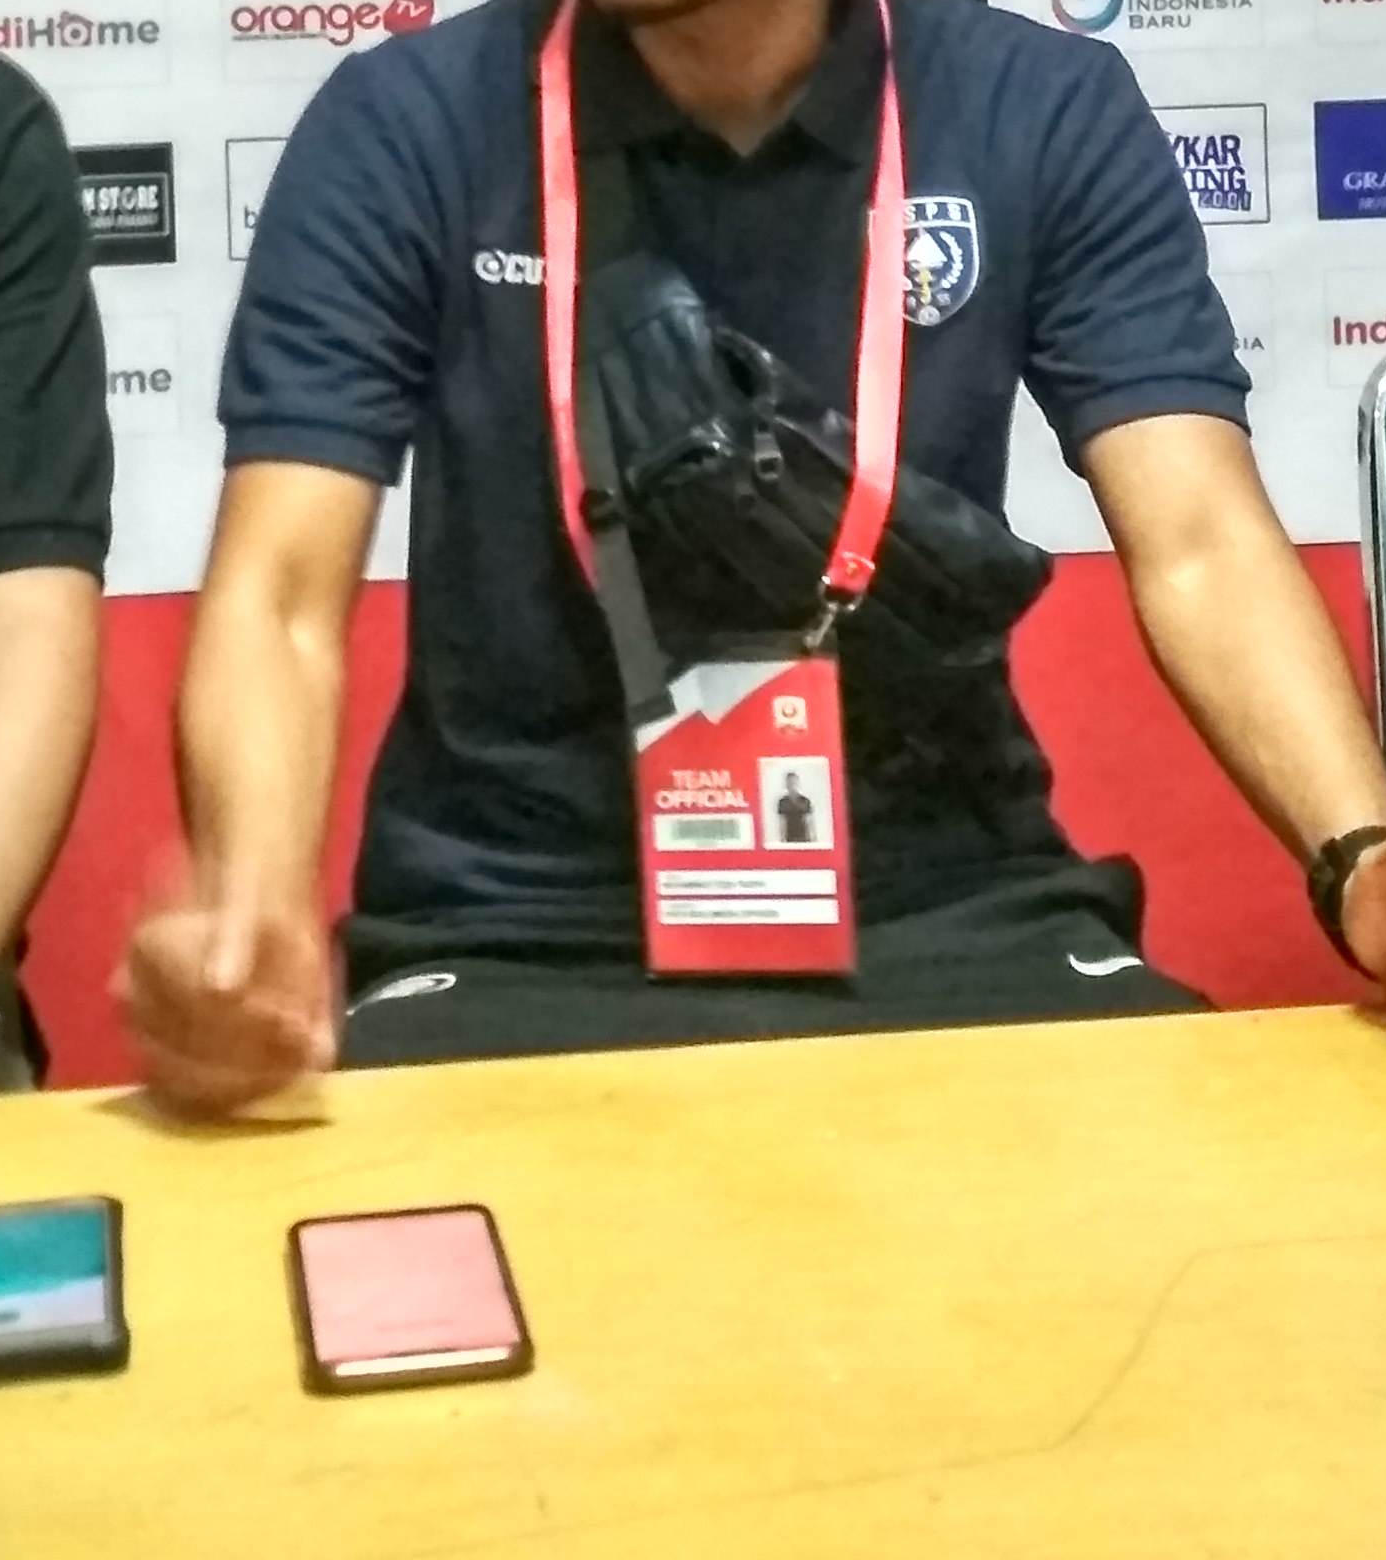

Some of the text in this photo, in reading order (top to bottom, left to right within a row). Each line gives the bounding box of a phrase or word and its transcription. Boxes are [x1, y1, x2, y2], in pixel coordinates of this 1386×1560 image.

[231, 0, 380, 46] orange
[99, 184, 159, 212] STORE
[904, 203, 962, 222] SPS
[671, 770, 732, 790] TEAM
[656, 790, 750, 809] OFFICIAL
